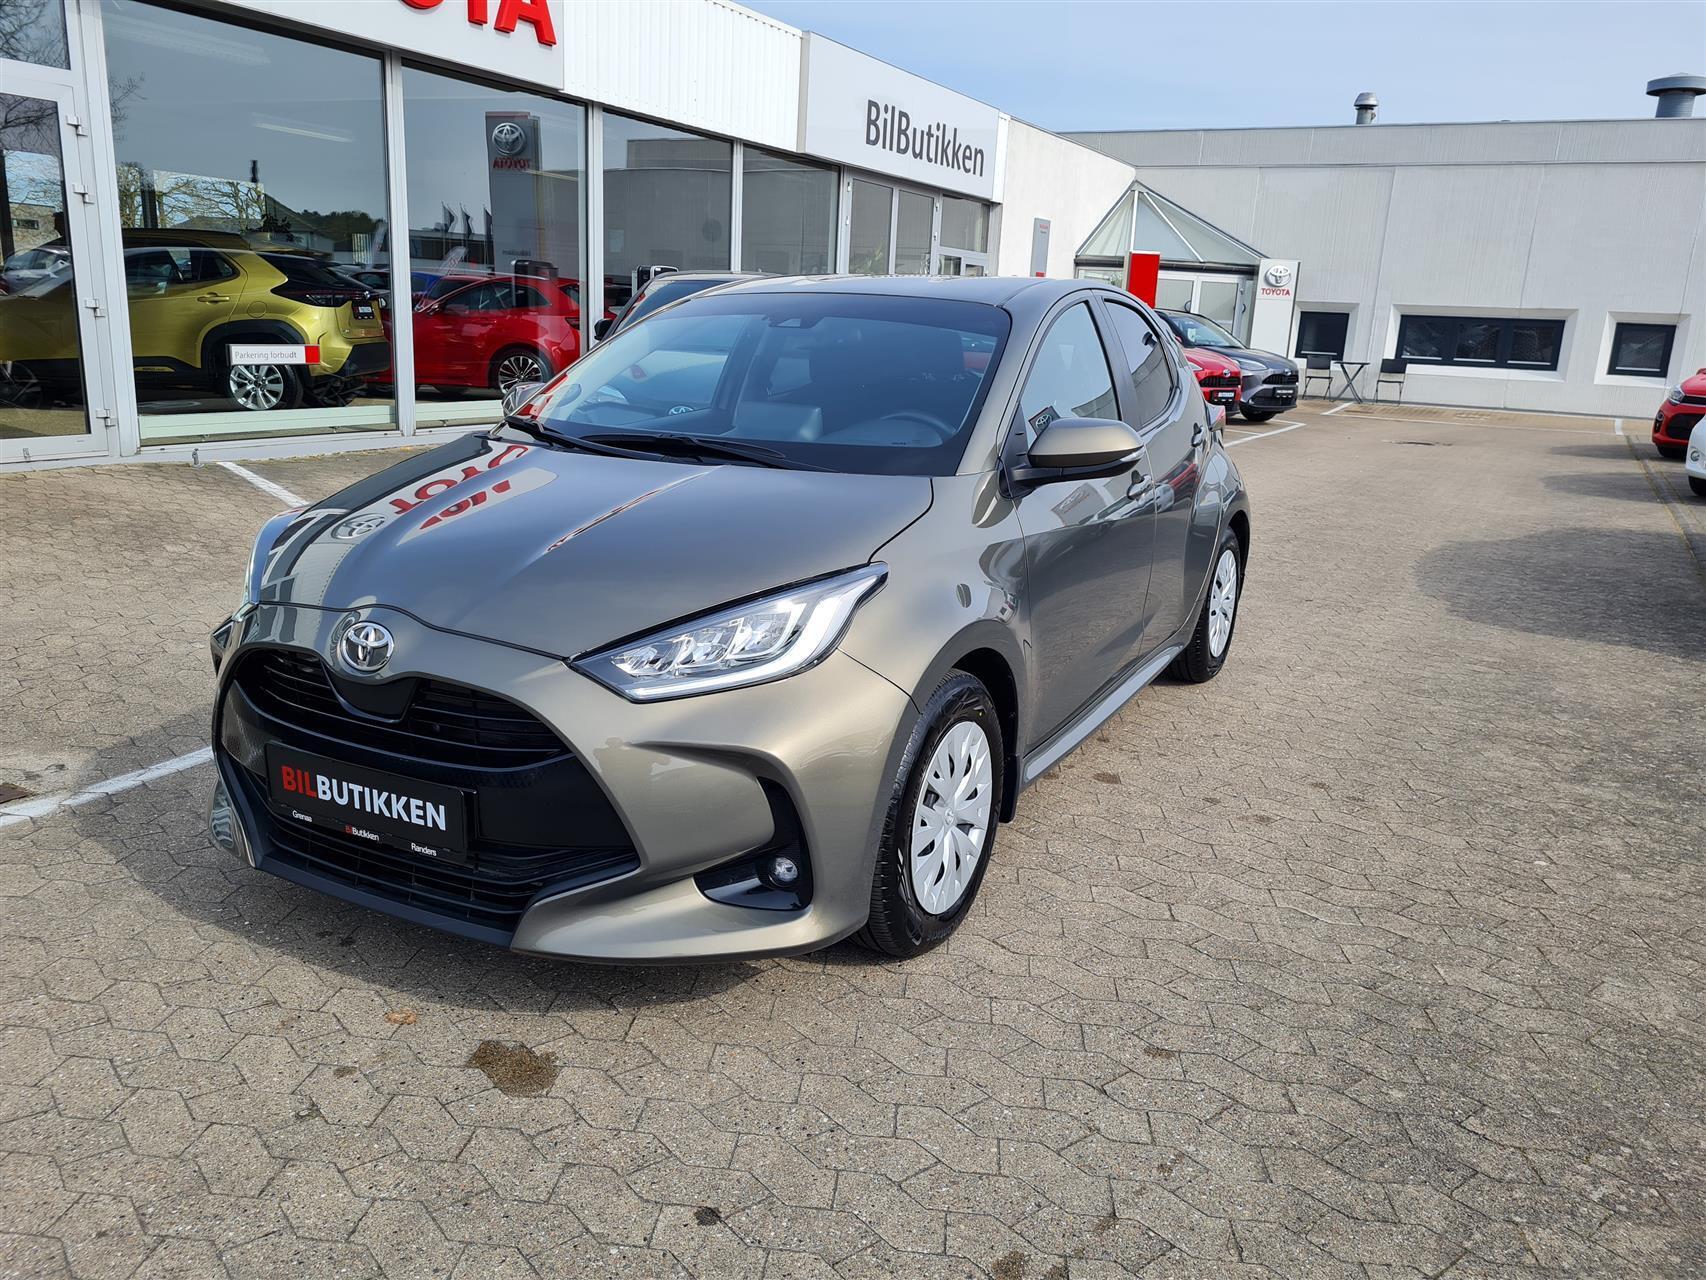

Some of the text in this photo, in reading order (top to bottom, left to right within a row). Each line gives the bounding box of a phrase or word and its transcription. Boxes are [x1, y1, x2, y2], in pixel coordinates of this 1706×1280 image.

[865, 99, 985, 177] BilButikken
[1261, 288, 1291, 296] TOYOTA
[234, 351, 297, 360] Parkering forbudt
[281, 765, 447, 831] BILBUTIKKEN
[411, 842, 437, 857] Randers
